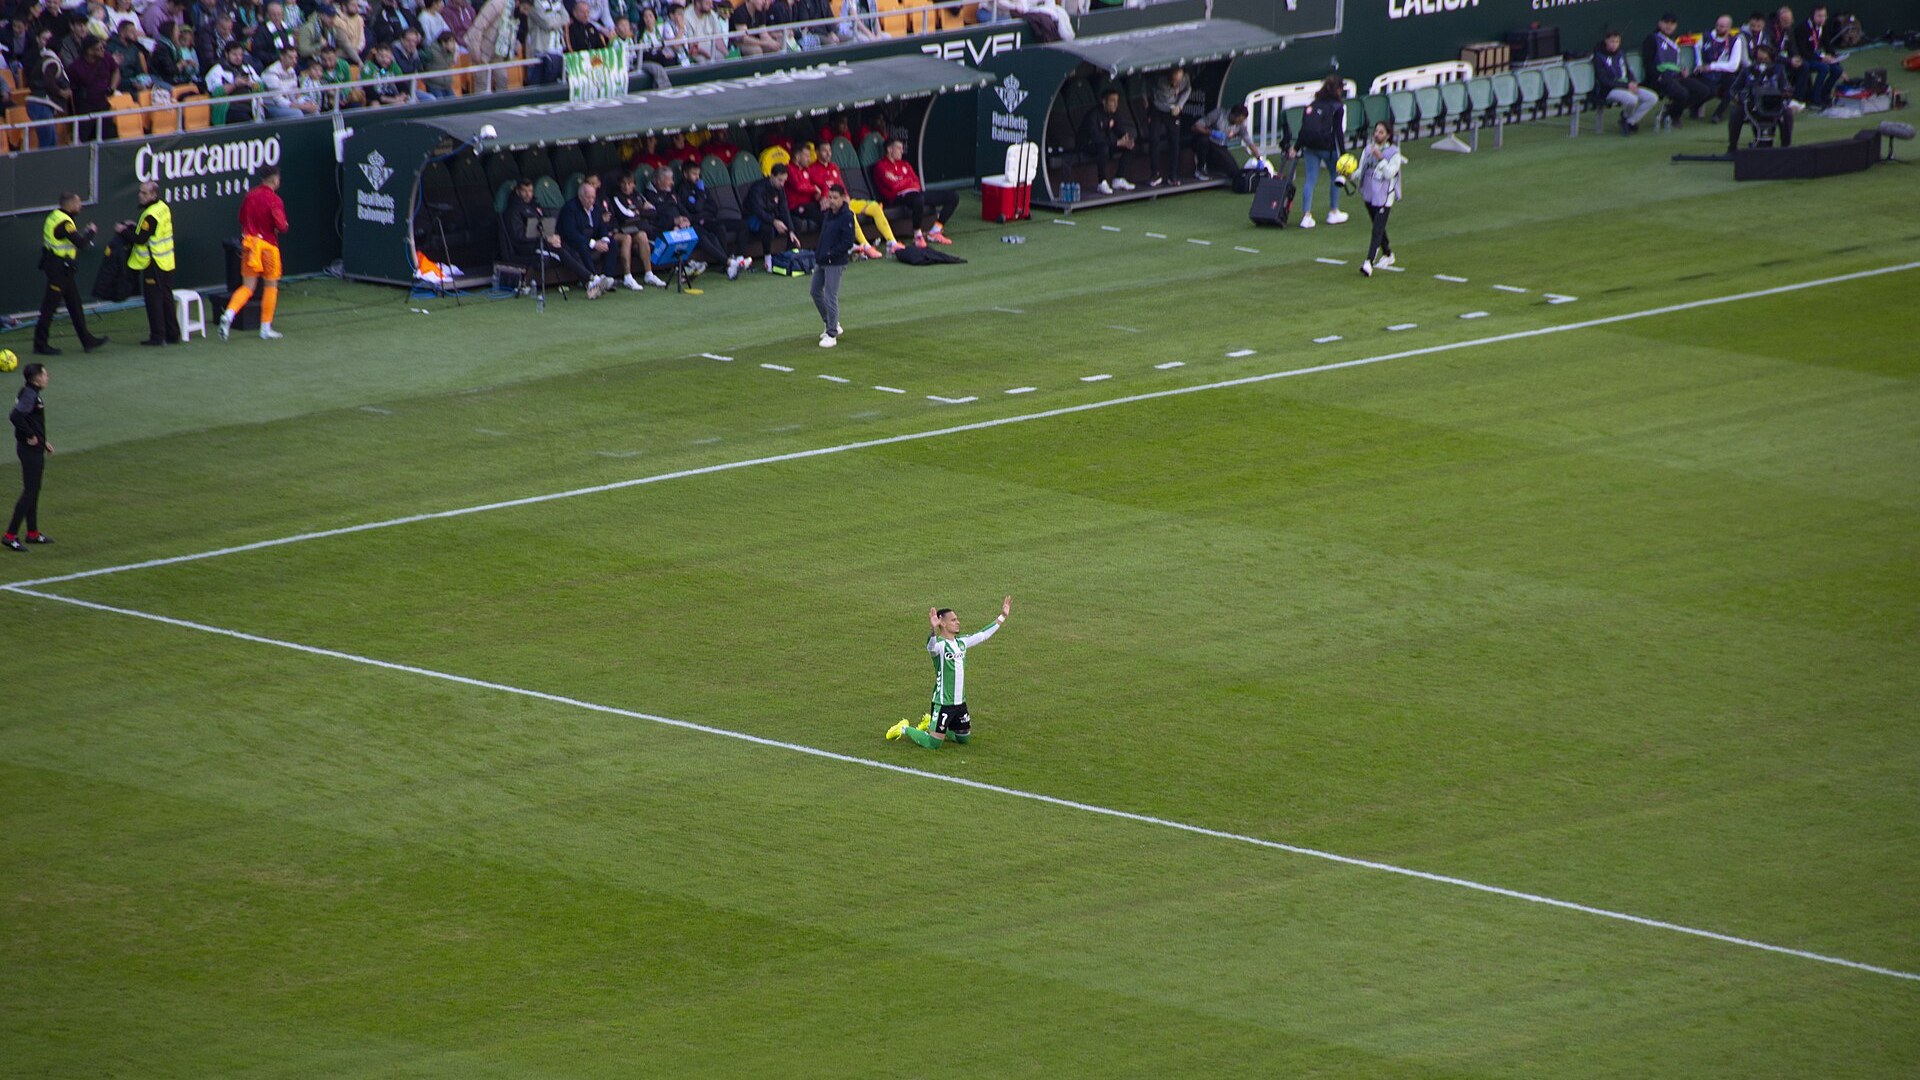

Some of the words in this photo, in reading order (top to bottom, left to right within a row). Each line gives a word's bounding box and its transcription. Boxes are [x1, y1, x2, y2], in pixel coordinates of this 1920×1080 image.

[1388, 0, 1479, 19] LALI
[992, 111, 1009, 128] Real
[1009, 114, 1028, 131] Betis
[135, 136, 280, 183] Cruzcampo
[165, 183, 207, 203] DESDE
[941, 713, 948, 726] 7
